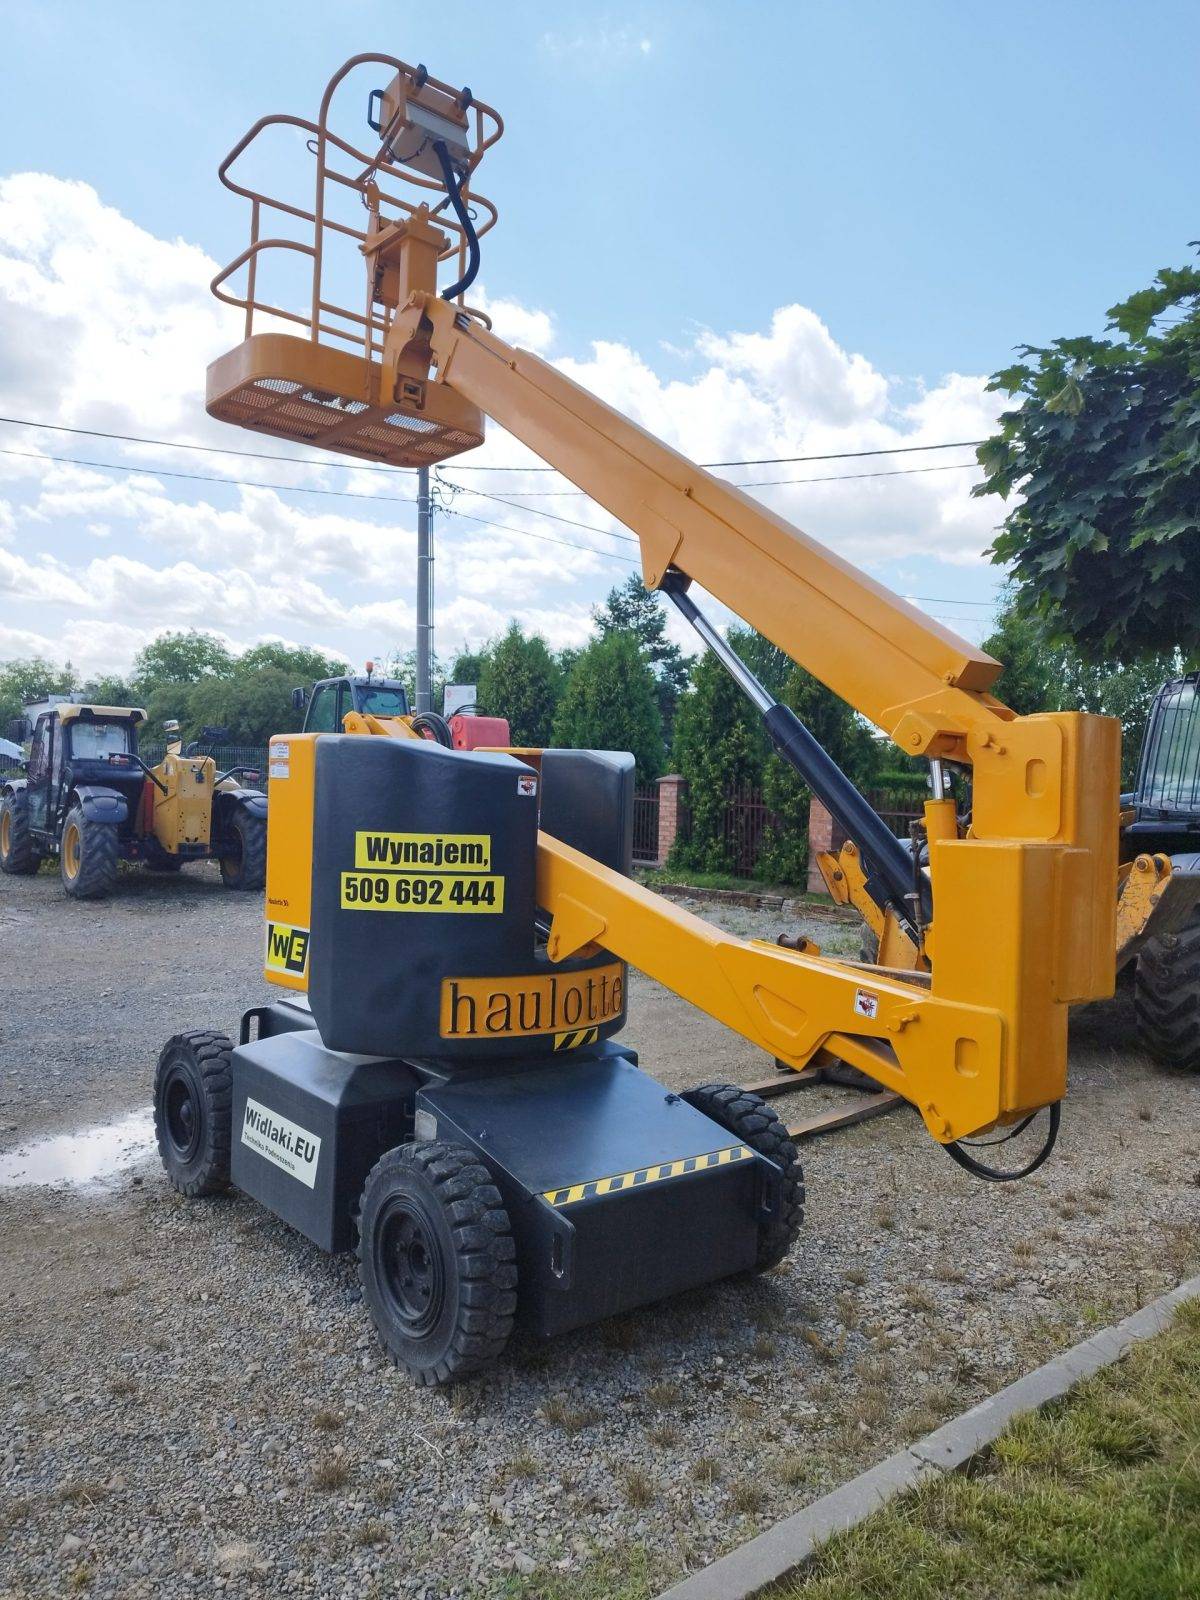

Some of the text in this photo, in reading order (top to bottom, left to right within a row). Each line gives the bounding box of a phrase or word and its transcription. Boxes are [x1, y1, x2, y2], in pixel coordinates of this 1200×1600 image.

[366, 836, 489, 867] Wynajem,
[345, 876, 496, 906] 509 692 444
[448, 975, 622, 1034] haulotte
[245, 1106, 316, 1164] Widlaki.EU
